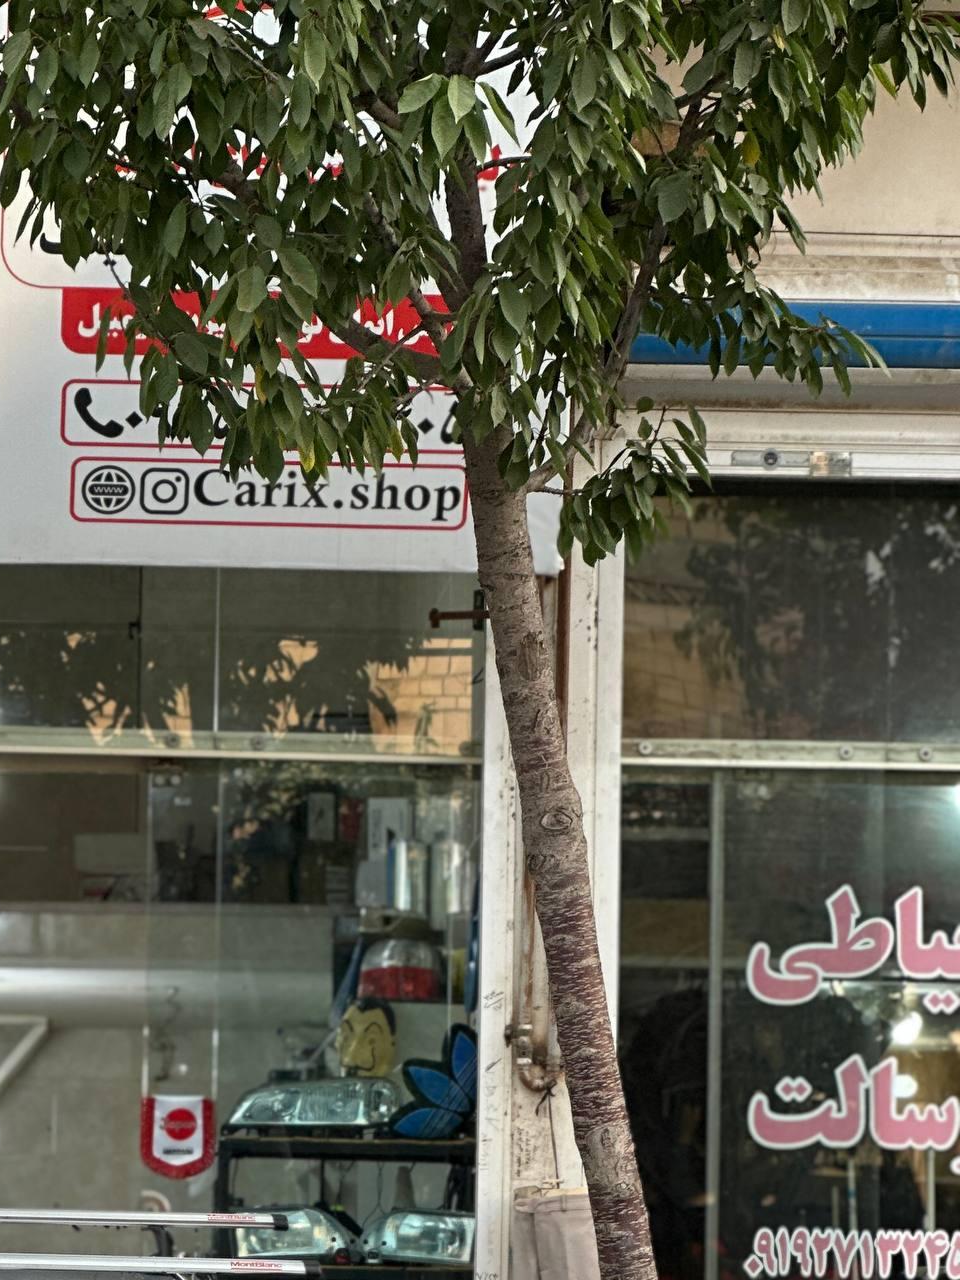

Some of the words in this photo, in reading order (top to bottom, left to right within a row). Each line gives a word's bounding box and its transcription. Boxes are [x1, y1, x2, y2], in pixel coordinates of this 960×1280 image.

[93, 485, 125, 494] www
[193, 467, 462, 522] Carix.shop
[746, 884, 960, 1015] یاطی
[747, 1053, 960, 1174] سالت
